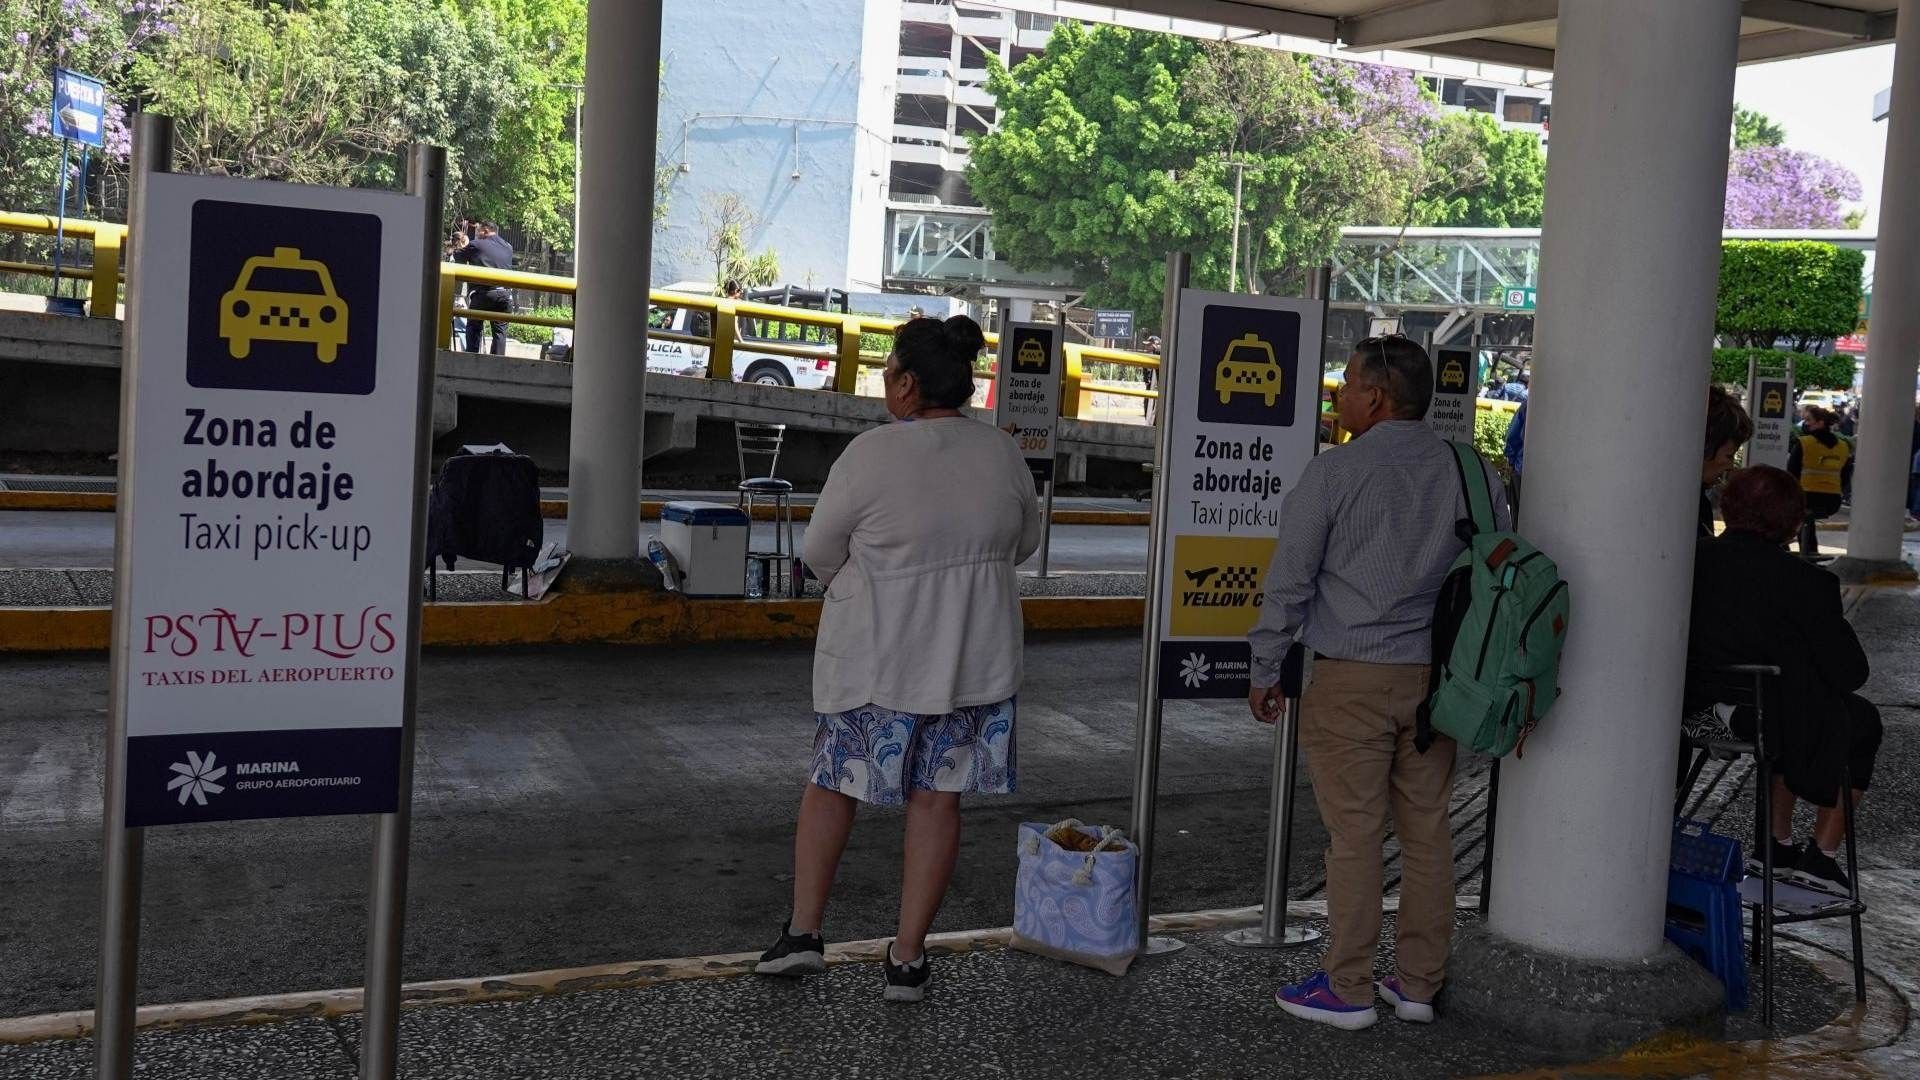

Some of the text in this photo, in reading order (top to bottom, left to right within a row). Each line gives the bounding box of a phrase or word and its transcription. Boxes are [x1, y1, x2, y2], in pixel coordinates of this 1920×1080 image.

[1009, 377, 1042, 389] Zona de
[1008, 390, 1045, 403] abordaje
[1434, 397, 1461, 408] Zona de
[1008, 401, 1022, 413] Taxi
[1433, 408, 1464, 422] abordaje
[183, 408, 336, 449] Zona de
[1022, 426, 1049, 438] SITIO
[1020, 438, 1048, 450] 300
[1194, 435, 1273, 462] Zona de
[181, 459, 354, 511] abordaje
[1193, 467, 1282, 500] abordaje
[1191, 500, 1279, 533] Taxi pick-u
[179, 512, 371, 561] Taxi pick-up
[1182, 592, 1265, 607] YELLOW C
[1215, 661, 1249, 670] MARINA
[142, 667, 394, 686] TAXIS DEL AEROPUERTO
[1214, 672, 1234, 680] GRUPO
[236, 761, 300, 775] MARINA
[236, 776, 362, 791] GRUPO AEROPORTUARIO
